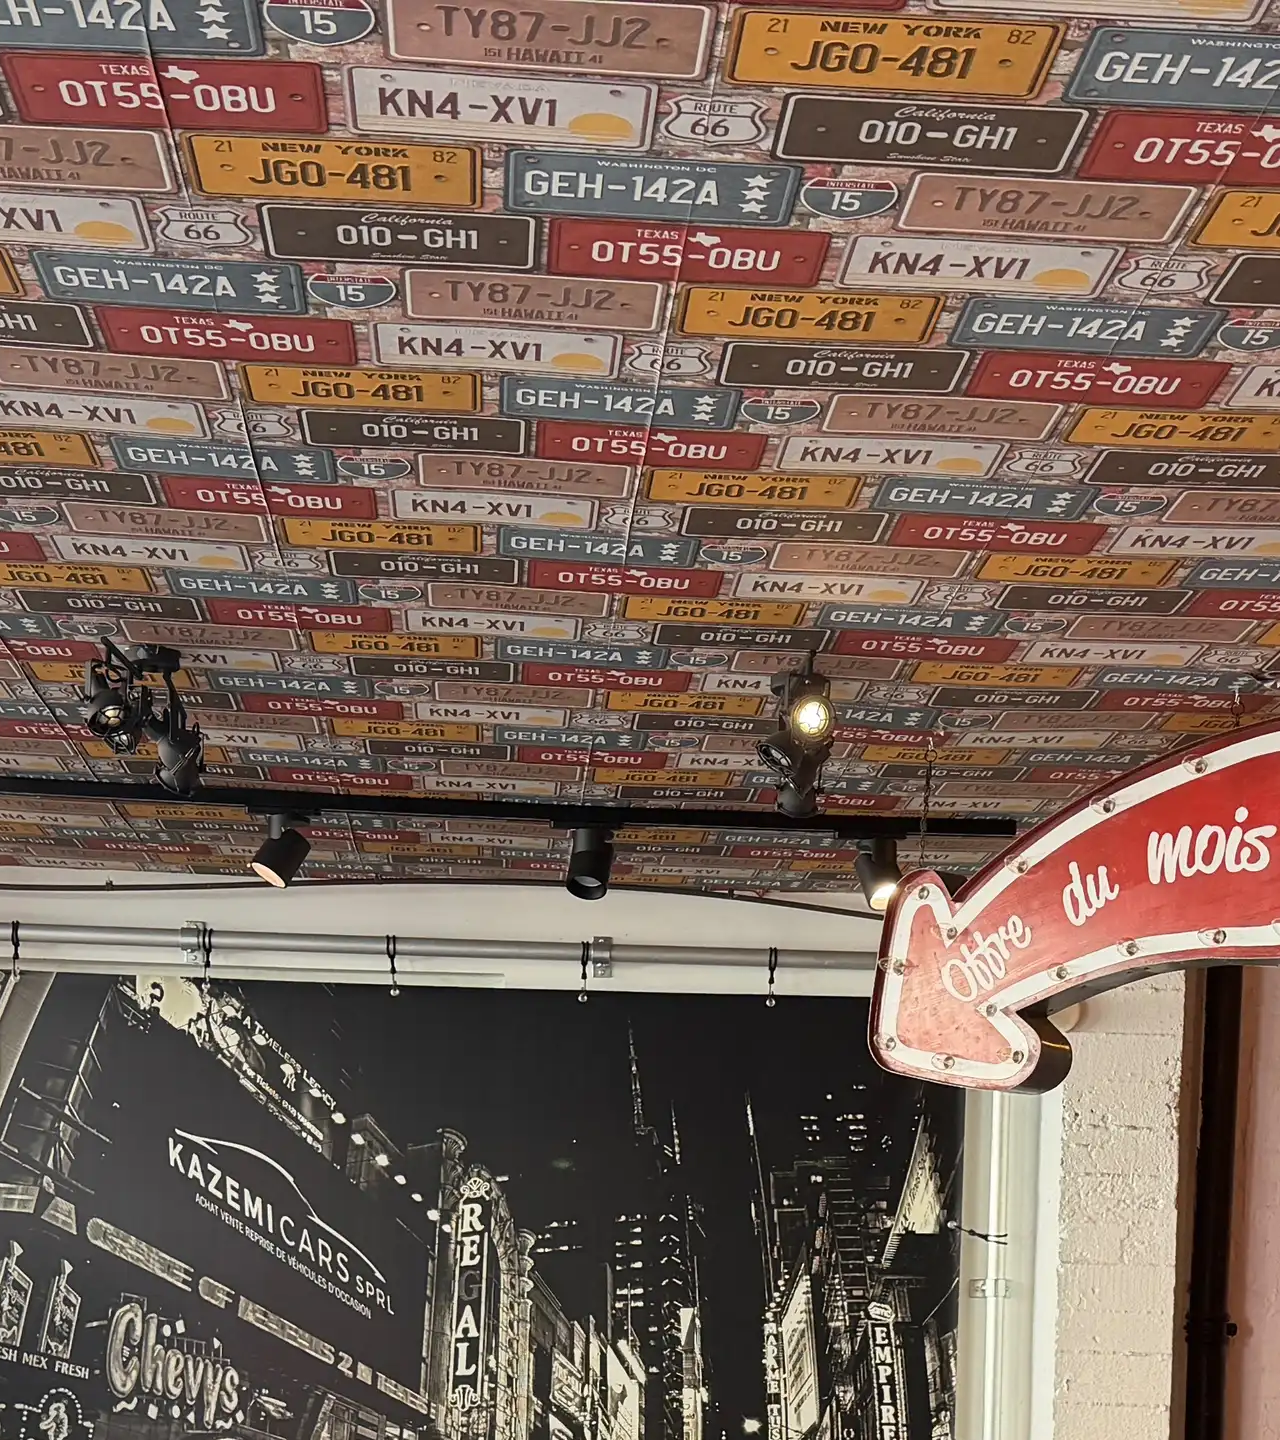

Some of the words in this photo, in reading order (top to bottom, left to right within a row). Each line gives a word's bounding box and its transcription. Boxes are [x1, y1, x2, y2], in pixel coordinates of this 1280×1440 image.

[299, 8, 339, 36] 15
[767, 16, 789, 32] 21
[820, 19, 889, 34] NEW
[900, 22, 984, 38] YORK
[1006, 27, 1037, 42] 82
[97, 61, 149, 74] TEXAS
[689, 114, 734, 138] 66
[891, 104, 998, 122] California
[1193, 119, 1248, 133] TEXAS
[261, 141, 322, 154] NEW
[334, 144, 408, 158] YORK
[524, 169, 725, 206] GEH-142A
[827, 190, 865, 212] 15
[181, 222, 223, 241] 66
[359, 212, 453, 227] California
[51, 266, 239, 298] GEH-142A
[968, 312, 1154, 341] GEH-142A
[887, 488, 1040, 508] GEH-142A
[1062, 860, 1120, 927] du
[1147, 806, 1278, 885] mois
[168, 1137, 273, 1233] KAZEMI
[279, 1215, 350, 1284] CARS
[355, 1274, 395, 1315] SPRL
[195, 1192, 219, 1216] ACHAT
[220, 1208, 245, 1234] VENTE
[245, 1226, 275, 1254] REPRISE
[275, 1246, 287, 1263] DE
[455, 1202, 485, 1376] REGAL
[22, 1351, 49, 1370] MEX
[54, 1359, 90, 1380] FRESH
[106, 1302, 240, 1430] Chevys
